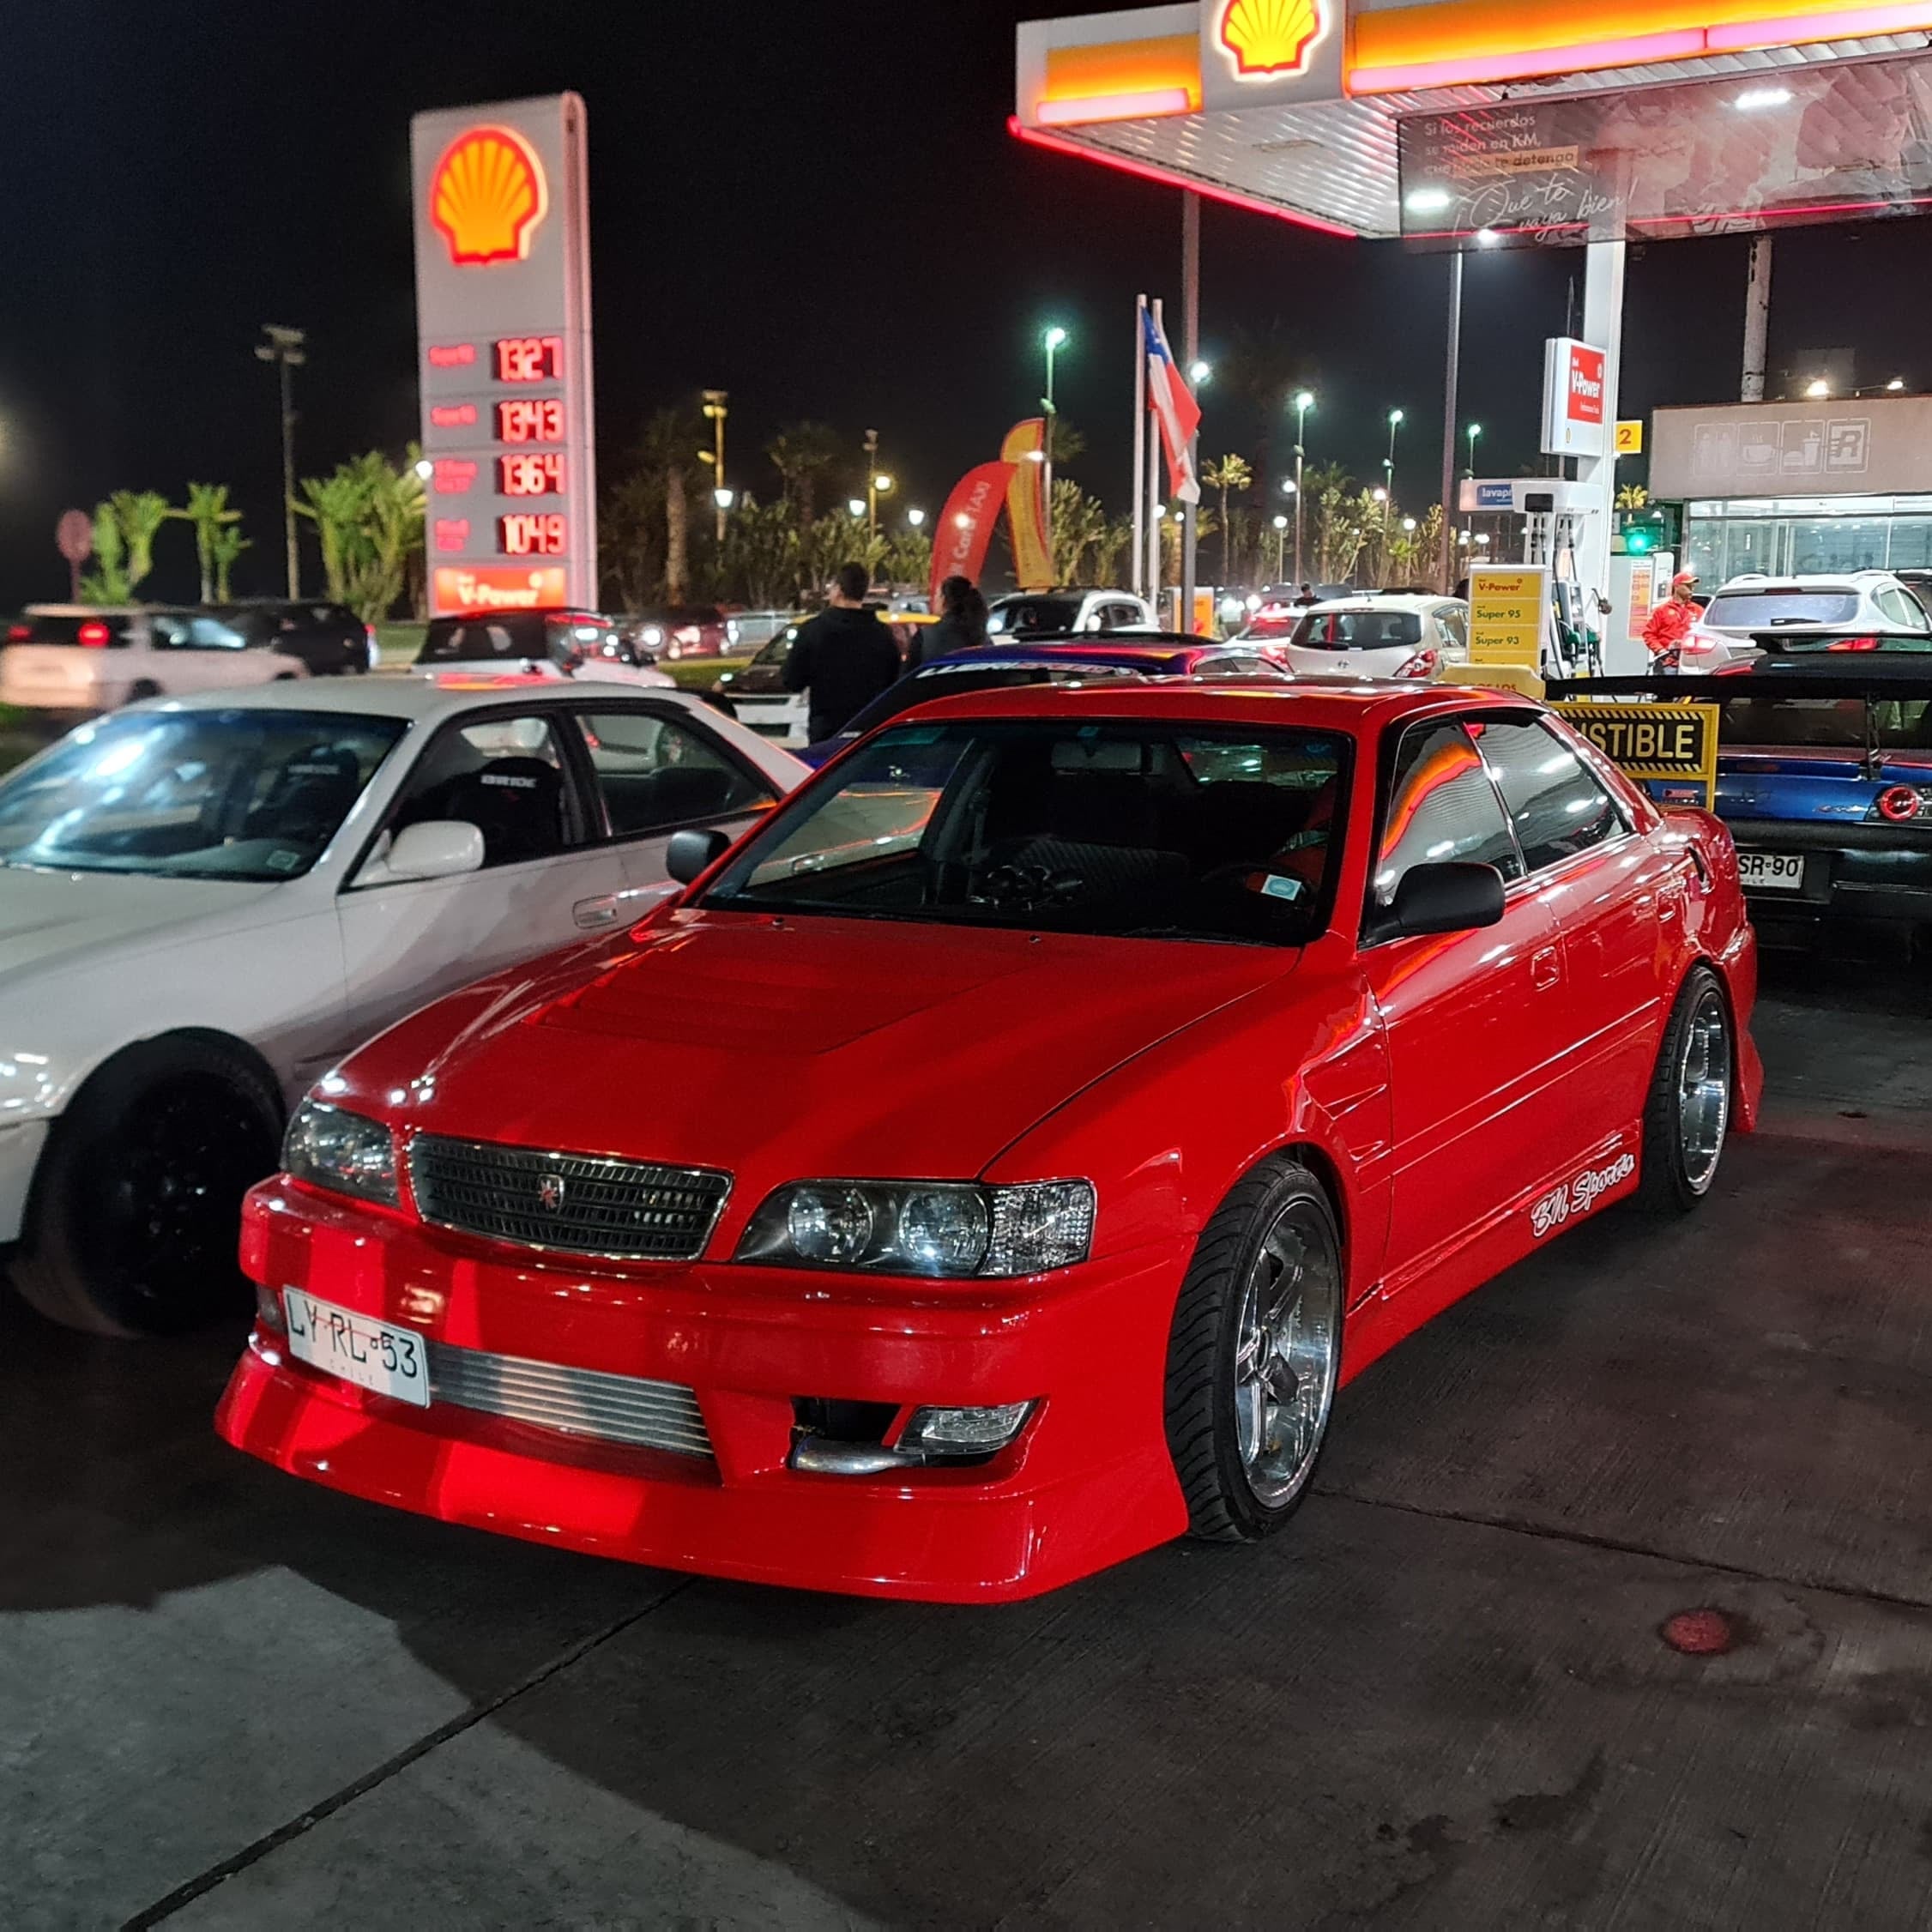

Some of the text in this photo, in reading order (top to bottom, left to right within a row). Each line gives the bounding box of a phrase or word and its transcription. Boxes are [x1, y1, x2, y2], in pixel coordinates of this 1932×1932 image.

[498, 335, 564, 381] 1327
[1572, 368, 1601, 399] V-Power
[499, 399, 565, 443] 1343
[1618, 428, 1632, 445] 2
[500, 453, 565, 496] 1364
[503, 514, 566, 555] 1049
[457, 583, 539, 606] V-Power
[1478, 583, 1521, 592] V-Power
[1476, 609, 1521, 620] Super 95
[1475, 636, 1519, 647] Super 93
[1571, 1152, 1635, 1212] Sports
